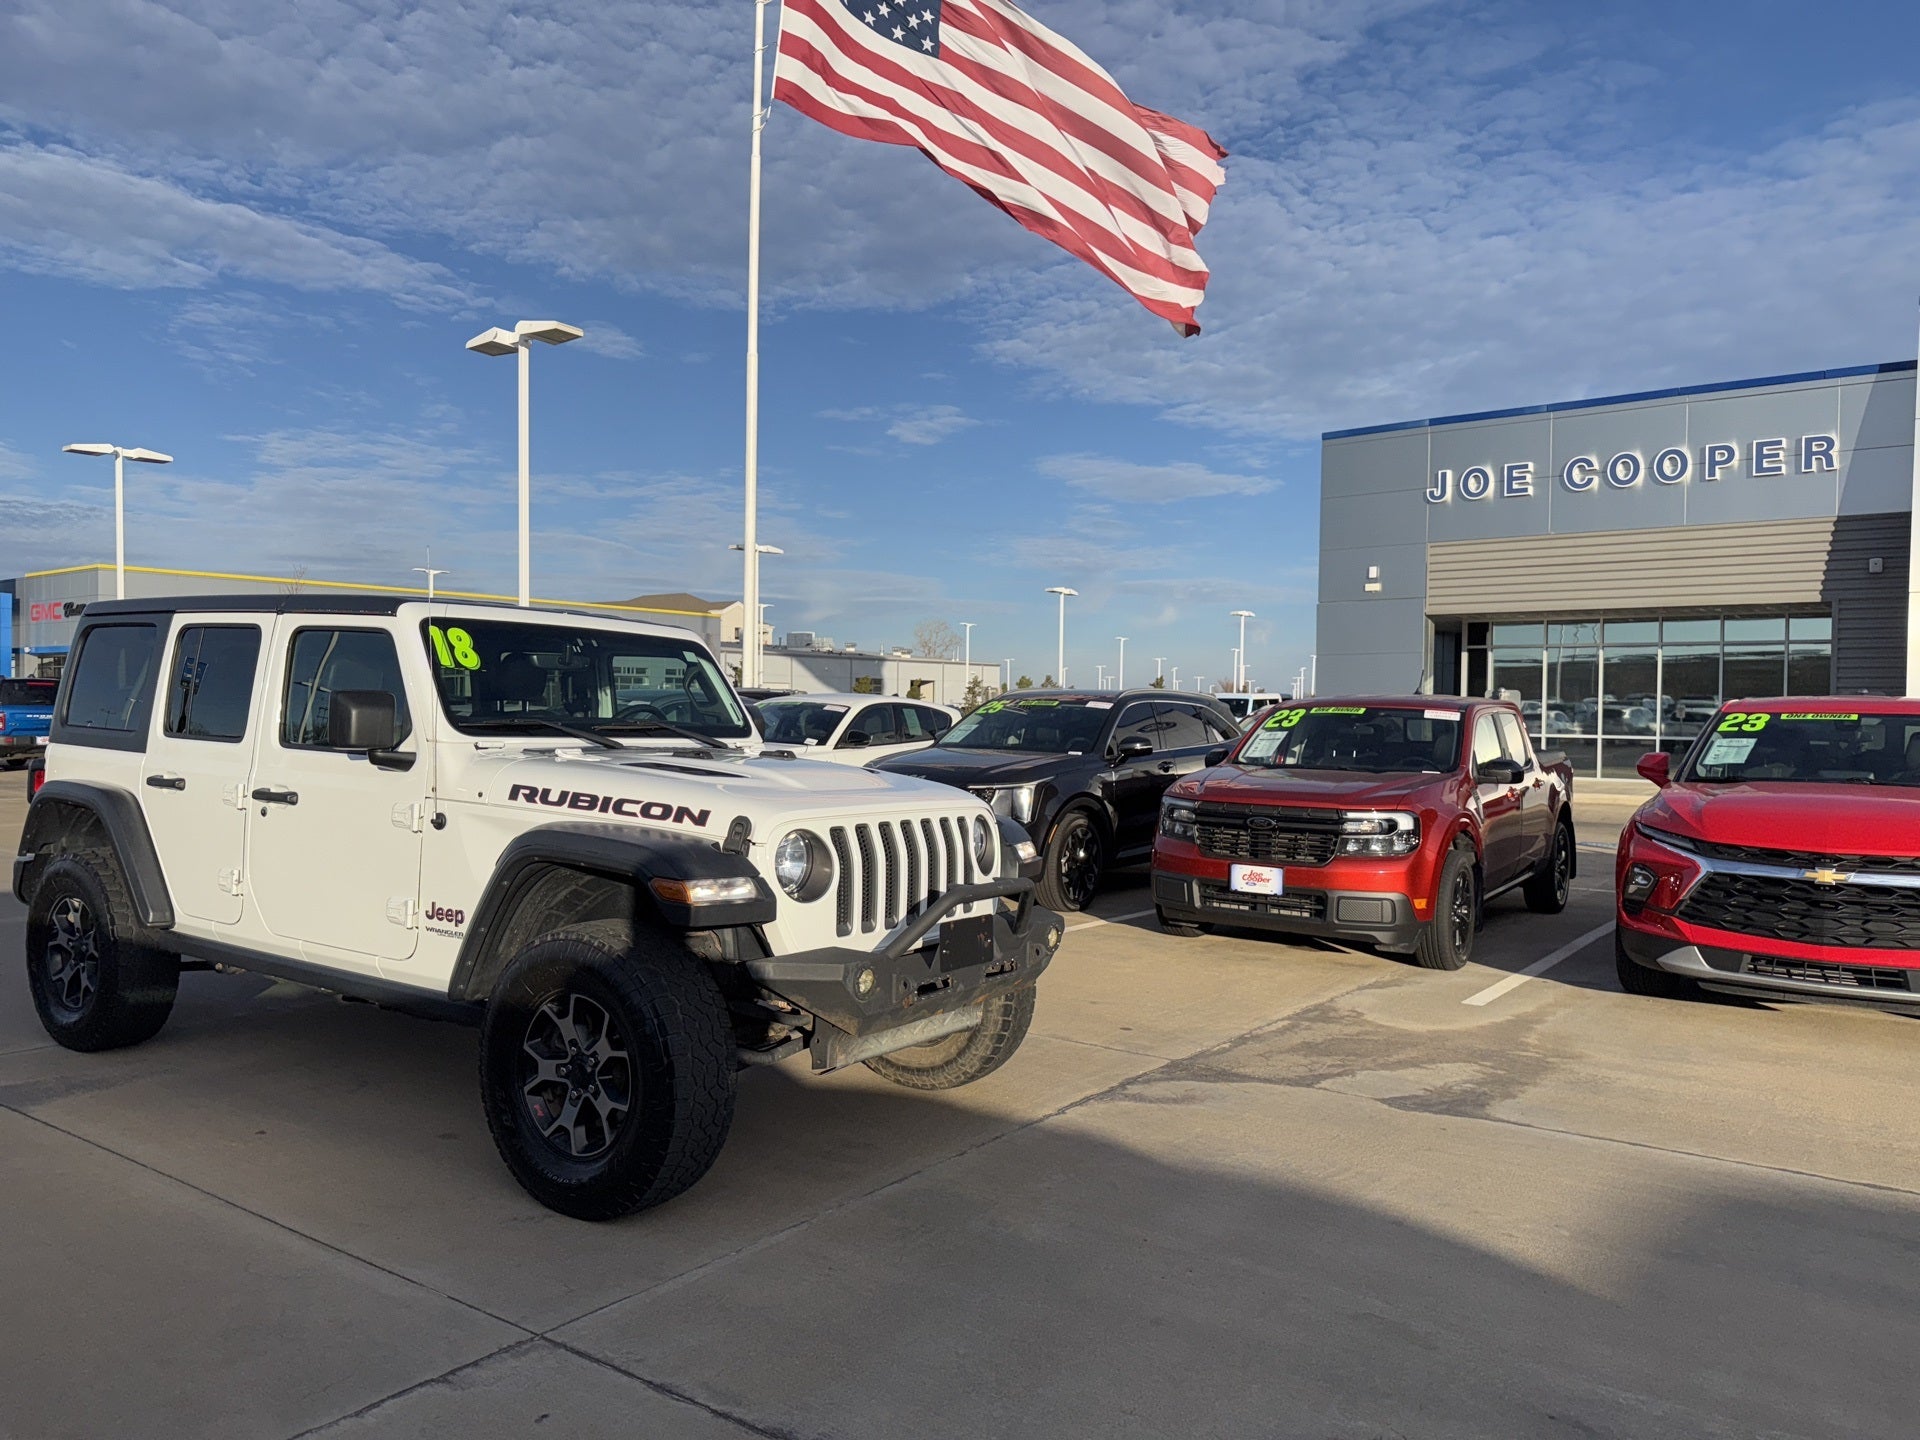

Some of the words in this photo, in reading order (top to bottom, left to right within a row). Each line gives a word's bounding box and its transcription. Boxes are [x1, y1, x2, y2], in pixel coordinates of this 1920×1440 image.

[1426, 462, 1533, 503] JOE
[1563, 435, 1838, 492] COOPER
[31, 601, 62, 622] GMC
[429, 625, 481, 670] 18
[1264, 708, 1306, 729] 23
[1717, 713, 1770, 732] 23
[508, 783, 711, 827] RUBICON
[1242, 873, 1272, 884] Cooper
[1248, 869, 1264, 878] Joe
[425, 901, 465, 927] Jeep
[425, 926, 464, 937] WRANGLER
